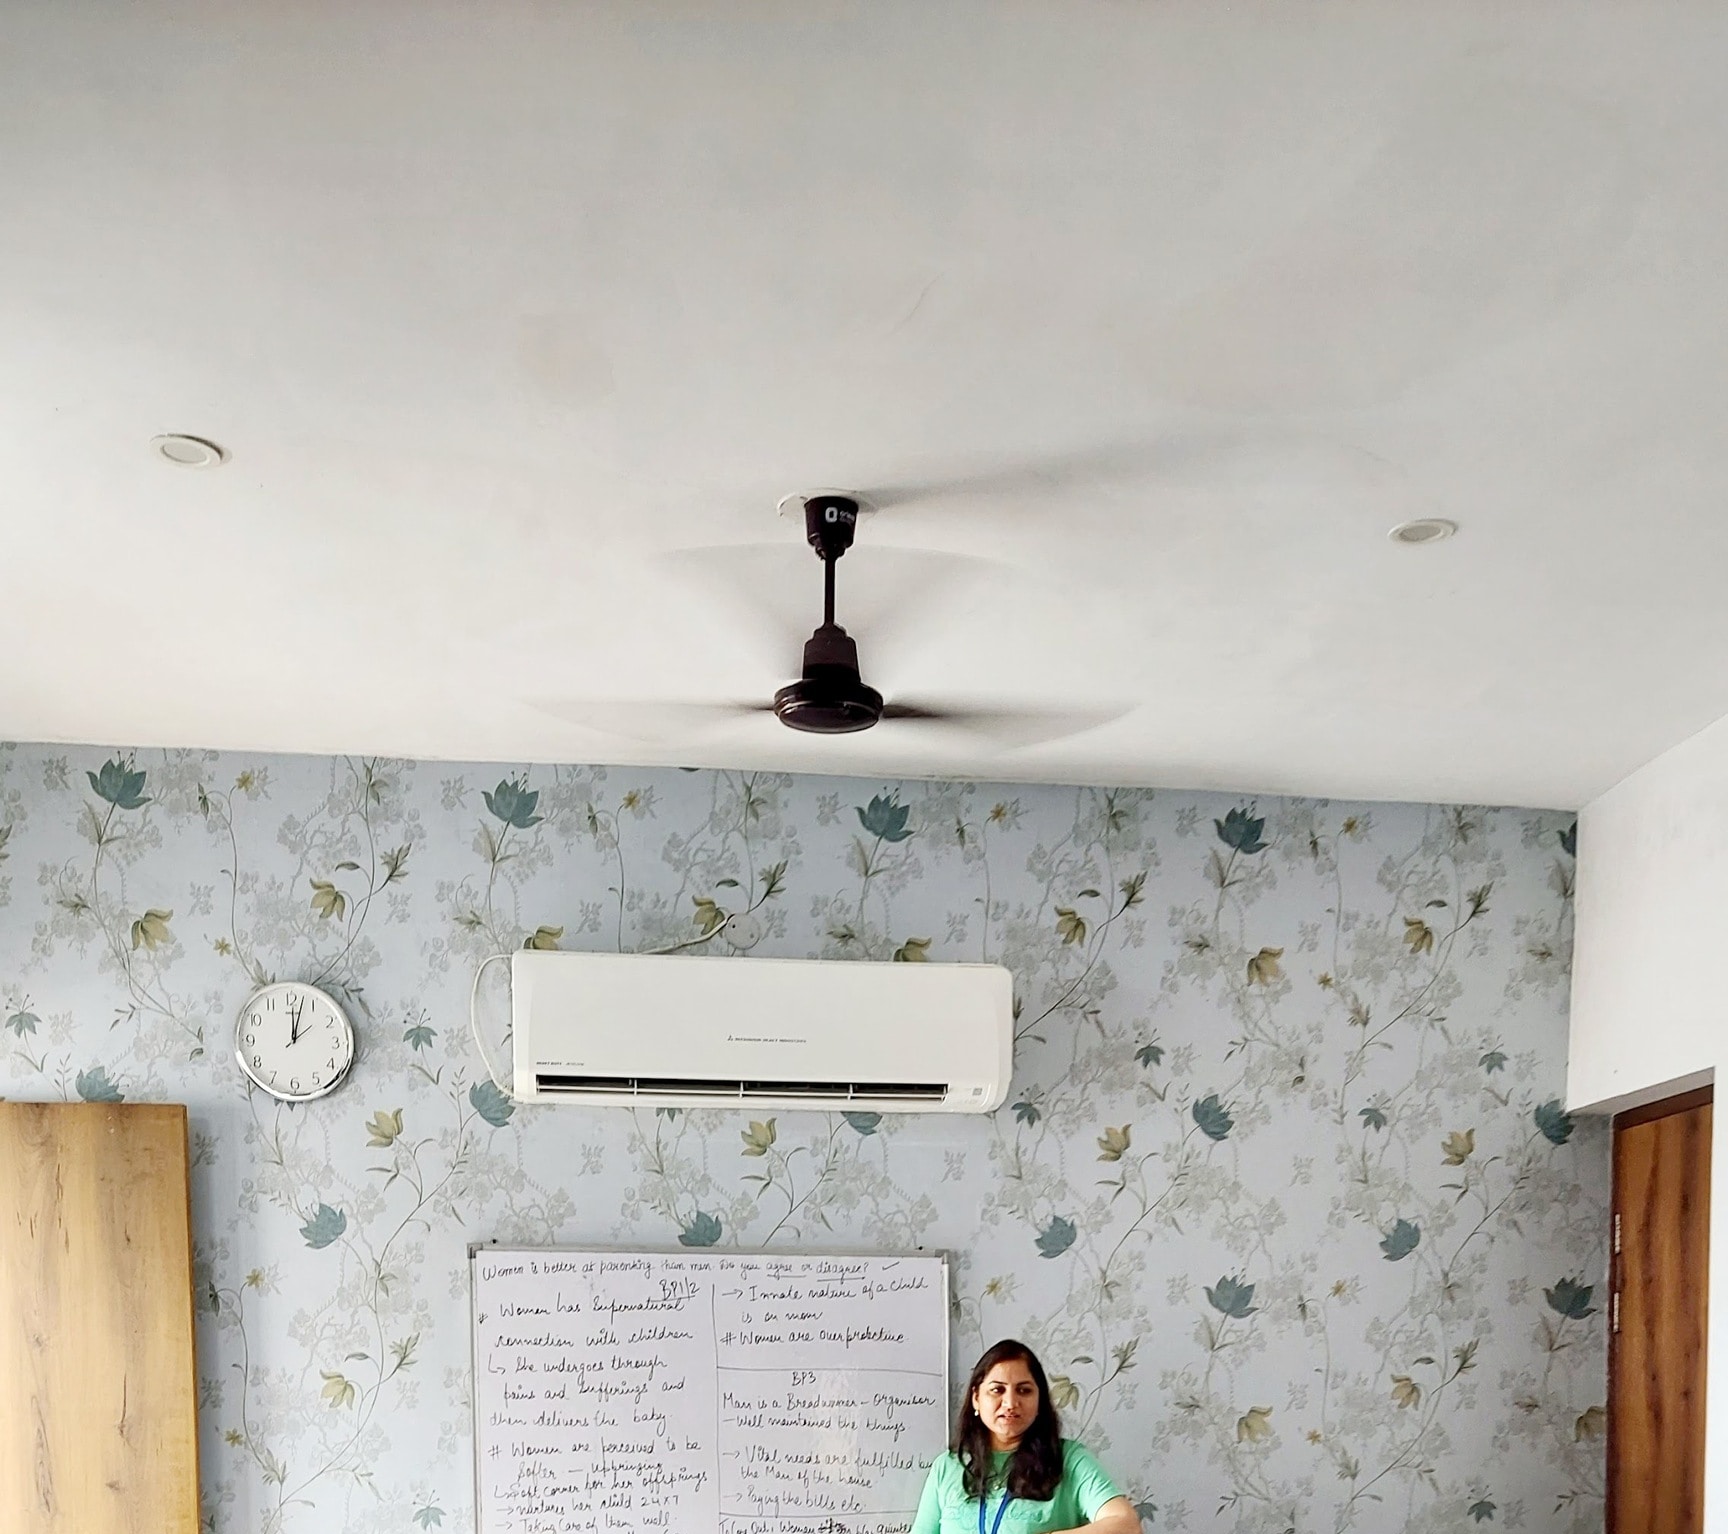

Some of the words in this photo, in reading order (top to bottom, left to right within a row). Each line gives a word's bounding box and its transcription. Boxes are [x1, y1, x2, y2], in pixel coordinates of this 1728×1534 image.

[250, 1013, 262, 1027] 10
[326, 1015, 334, 1029] 2
[245, 1034, 255, 1047] 9
[332, 1036, 340, 1049] 3
[253, 1055, 262, 1068] 8
[326, 1057, 335, 1070] 4
[269, 1070, 278, 1085] 7
[290, 1077, 300, 1090] 6
[312, 1072, 320, 1085] 5
[483, 1265, 523, 1281] Women
[544, 1262, 577, 1274] better
[862, 1280, 874, 1300] of
[500, 1302, 550, 1318] Women
[557, 1292, 581, 1313] has
[586, 1327, 620, 1347] with
[628, 1326, 693, 1344] children
[740, 1331, 784, 1345] Women
[789, 1332, 814, 1342] are
[544, 1356, 604, 1386] undergoes
[611, 1354, 668, 1381] through
[791, 1371, 817, 1387] BP3
[544, 1383, 568, 1400] and
[661, 1376, 686, 1391] and
[723, 1392, 752, 1410] Man
[758, 1397, 768, 1409] is
[490, 1411, 527, 1427] then
[534, 1410, 590, 1427] delivers
[594, 1410, 619, 1426] the
[837, 1415, 858, 1430] the
[511, 1441, 562, 1457] Women
[572, 1441, 590, 1452] are
[686, 1435, 703, 1450] be
[745, 1444, 782, 1464] Vital
